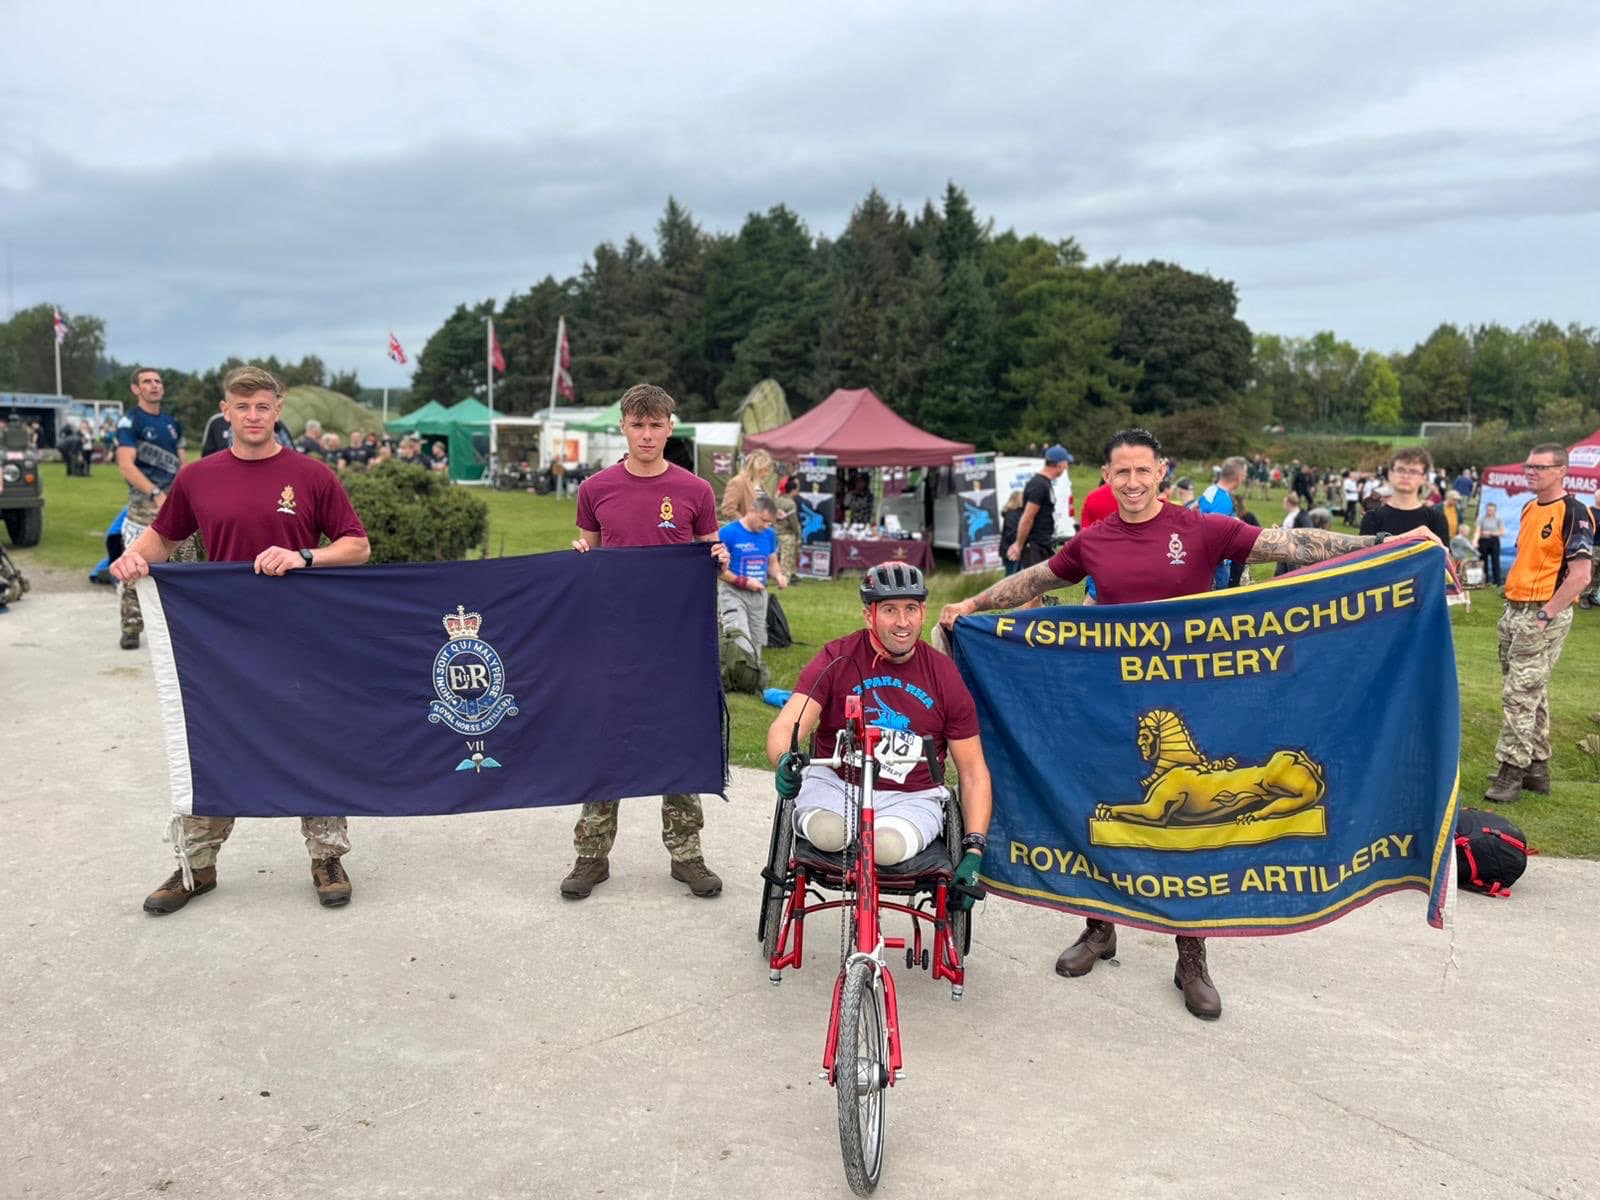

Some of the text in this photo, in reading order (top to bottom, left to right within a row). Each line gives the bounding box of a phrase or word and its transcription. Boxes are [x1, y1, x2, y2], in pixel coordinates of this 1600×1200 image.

[1562, 476, 1598, 491] PARAS
[996, 578, 1416, 651] F (SPHINX) PARACHUTE
[436, 650, 450, 675] SOIT
[450, 641, 471, 652] QUI
[489, 666, 501, 698] PENSE
[1120, 645, 1286, 682] BATTERY
[863, 675, 903, 690] PARA
[434, 704, 455, 722] ROYAL
[455, 720, 481, 732] HORSE
[466, 740, 484, 751] VII
[1010, 834, 1415, 898] ROYAL HORSE ARTILLERY
